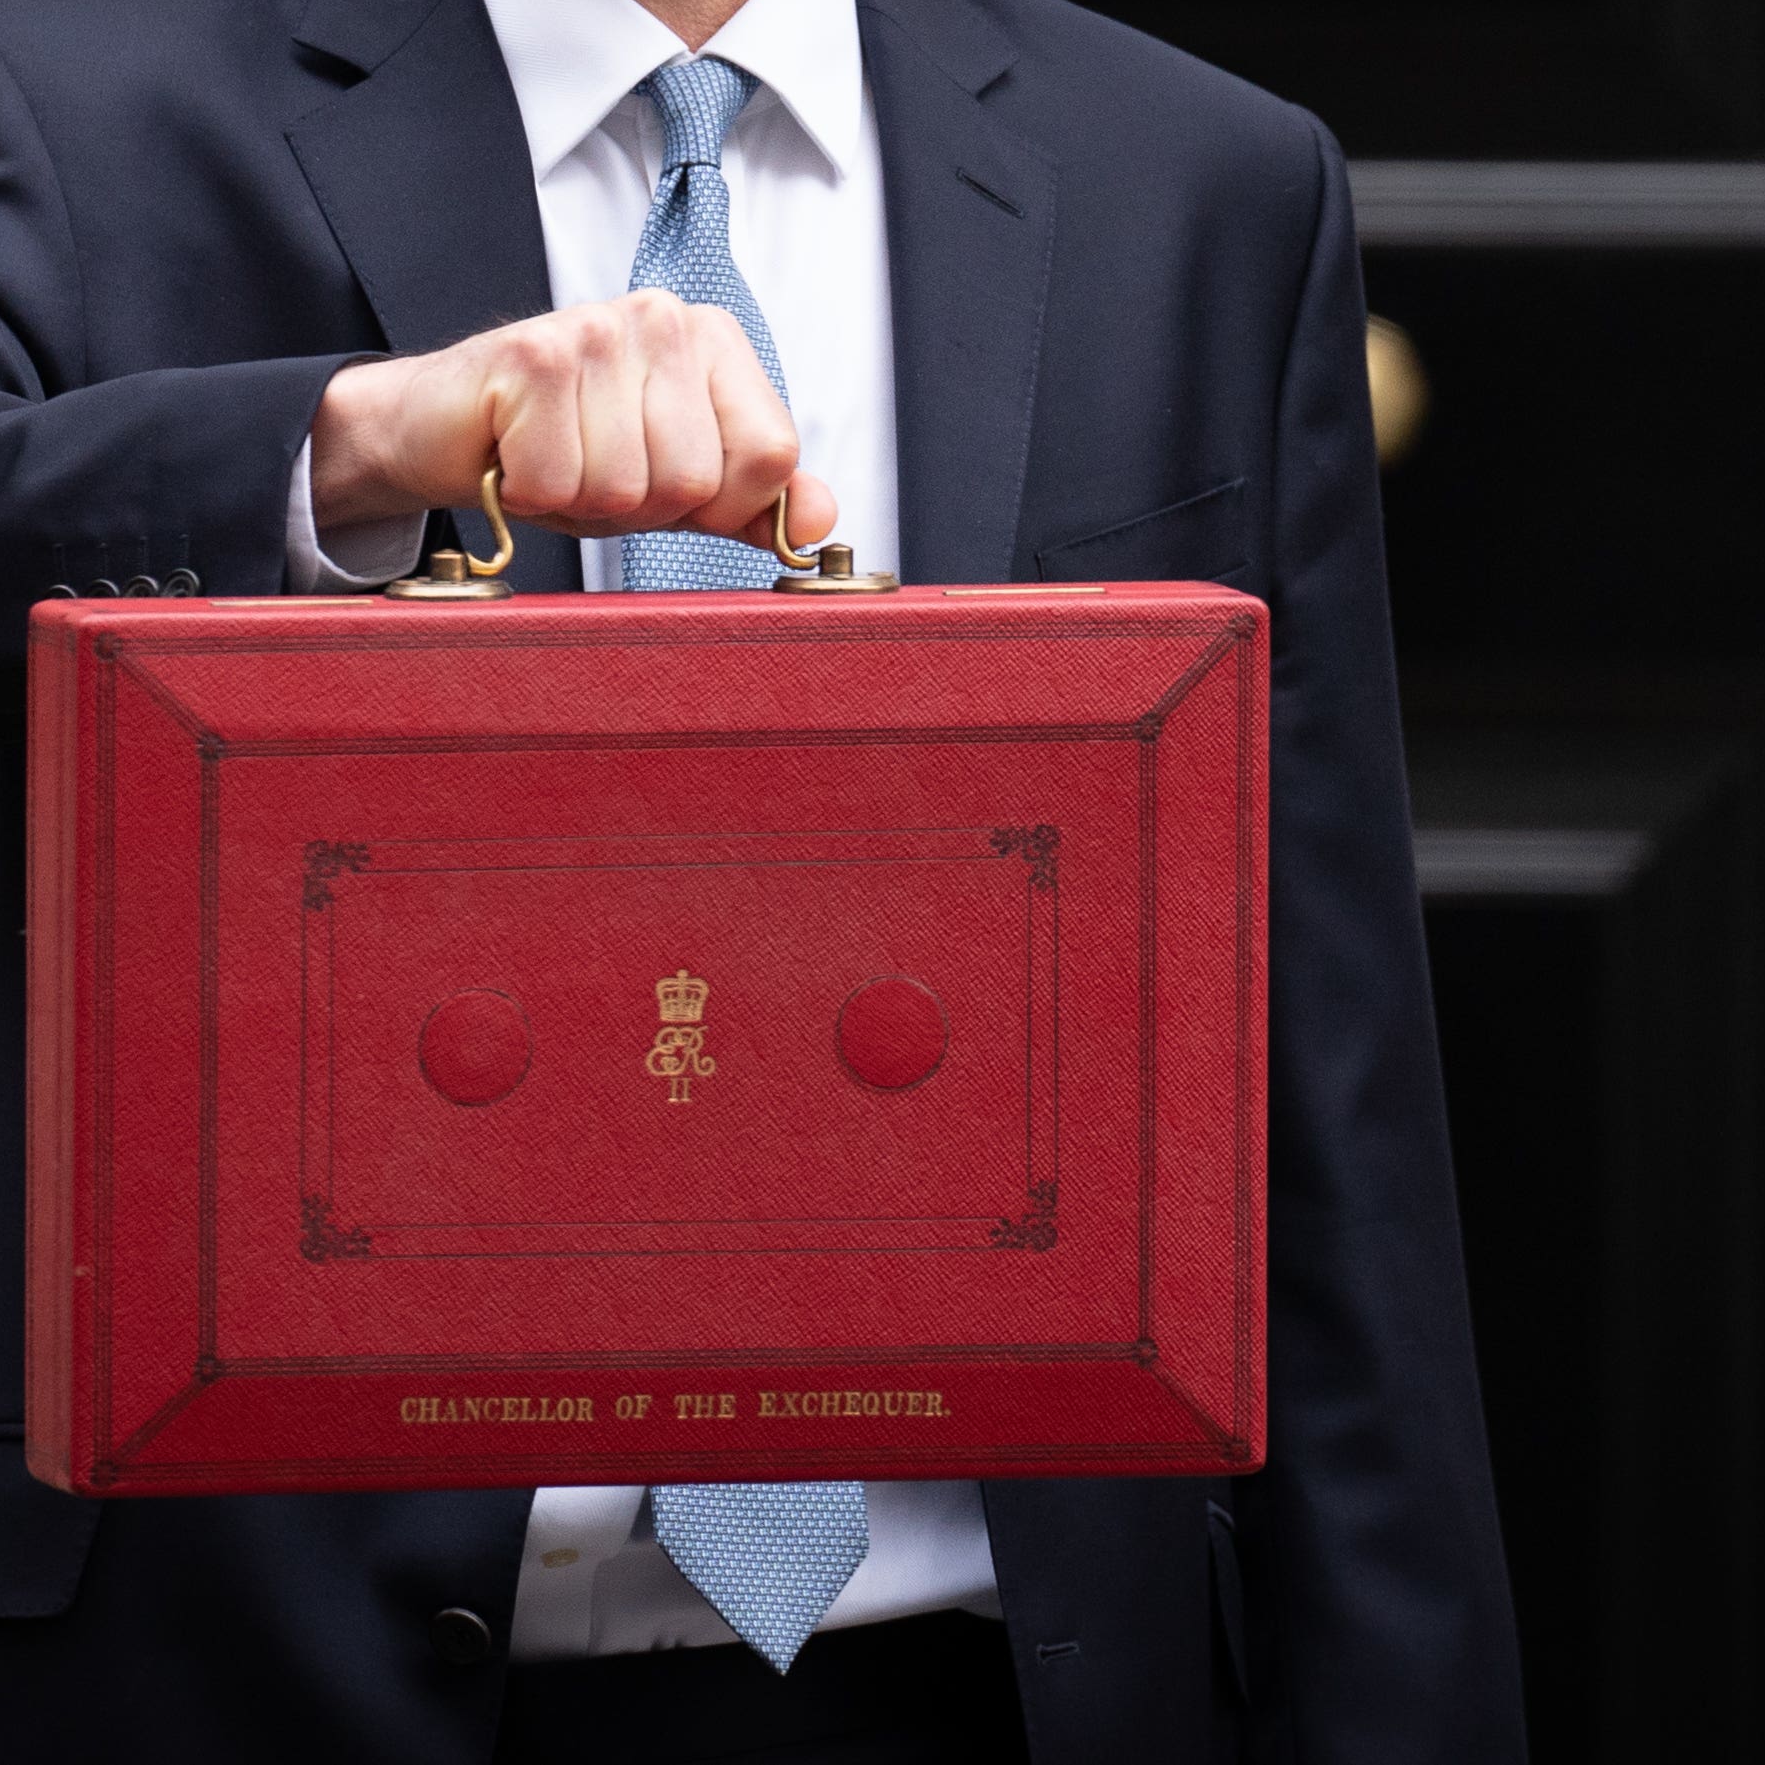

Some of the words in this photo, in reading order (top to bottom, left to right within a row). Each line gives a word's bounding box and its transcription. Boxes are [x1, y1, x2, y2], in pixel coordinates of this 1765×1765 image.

[399, 1395, 594, 1423] CHANCELLOR
[614, 1393, 652, 1420] OF
[673, 1393, 736, 1420] THE
[757, 1391, 952, 1417] EXCHEQUER.
